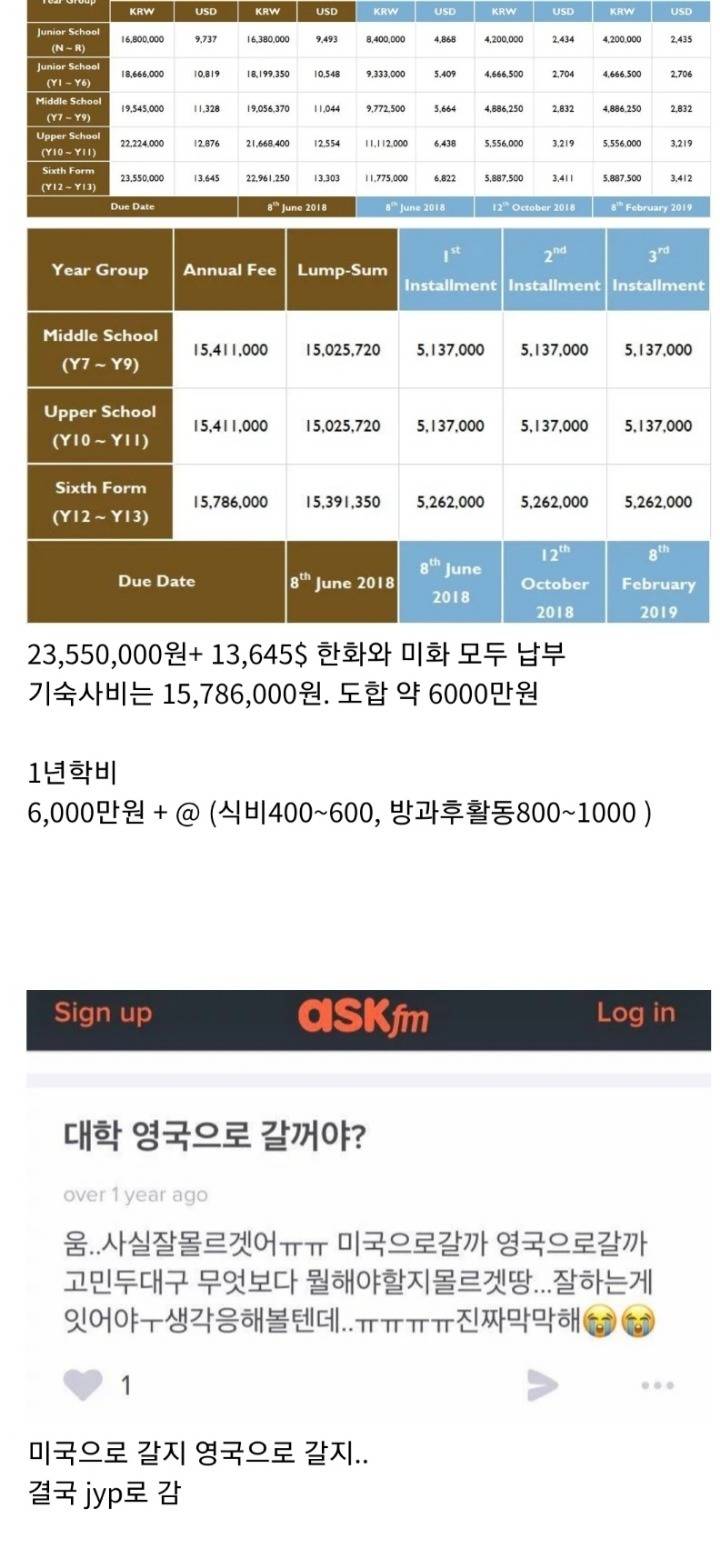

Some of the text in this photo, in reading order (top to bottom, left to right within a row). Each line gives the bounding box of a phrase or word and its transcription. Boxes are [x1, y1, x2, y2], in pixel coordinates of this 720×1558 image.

[129, 7, 155, 16] KRW
[194, 7, 218, 16] USD
[255, 7, 281, 16] KRW
[315, 7, 339, 16] USD
[373, 7, 399, 16] KRW
[434, 7, 456, 16] USD
[491, 7, 517, 16] KRW
[552, 7, 575, 16] USD
[610, 7, 635, 16] KRW
[670, 7, 693, 16] USD
[42, 166, 95, 175] Sixth Form
[120, 173, 165, 183] 23,550,000
[194, 173, 220, 183] 13,645
[246, 173, 290, 183] 22,961,250
[314, 173, 341, 183] 13,303
[364, 173, 409, 183] 11,775,000
[433, 173, 457, 183] 6,822
[484, 173, 524, 183] 5,887,500
[552, 173, 575, 183] 3,411
[602, 173, 642, 183] 5,887,500
[670, 173, 693, 183] 3,412
[544, 245, 567, 263] 2nd
[648, 245, 670, 263] 3rd
[51, 263, 149, 280] Year Group
[182, 262, 277, 277] Annual Fee
[297, 263, 388, 280] Lump-Sum
[405, 278, 497, 291] Installment
[509, 278, 601, 291] Installment
[613, 278, 705, 291] Installment
[43, 328, 160, 343] Middle School
[194, 342, 269, 358] 15,411,000
[306, 342, 381, 358] 15,025,720
[416, 342, 485, 358] 5,137,000
[520, 342, 589, 358] 5,137,000
[624, 342, 693, 358] 5,137,000
[61, 357, 91, 375] (Y7
[110, 357, 140, 375] Y9)
[44, 404, 157, 422] Upper School
[194, 419, 269, 435] 15,411,000
[306, 419, 381, 435] 15,025,720
[416, 419, 485, 435] 5,137,000
[520, 419, 589, 435] 5,137,000
[624, 419, 693, 435] 5,137,000
[52, 433, 91, 451] (Y10
[110, 433, 150, 451] Y11)
[55, 481, 147, 495] Sixth Form
[194, 495, 269, 511] 15,786,000
[306, 495, 381, 511] 15,391,350
[416, 495, 485, 511] 5,262,000
[520, 495, 589, 511] 5,262,000
[624, 495, 693, 511] 5,262,000
[52, 509, 91, 527] (Y12
[110, 509, 150, 527] Y13)
[542, 545, 570, 561] 12th
[648, 545, 670, 561] 8th
[420, 558, 482, 578] 8th June
[118, 574, 196, 588] Due Date
[290, 572, 395, 593] 8th June 2018
[521, 577, 590, 590] October
[622, 577, 697, 594] February
[432, 591, 470, 604] 2018
[536, 606, 574, 619] 2018
[640, 606, 678, 619] 2019
[54, 1000, 153, 1028] Sign up
[597, 1001, 676, 1028] Log in
[64, 1120, 367, 1152] 대학 영국으로 갈꺼야?
[63, 1187, 208, 1206] over 1 year ago
[338, 1230, 489, 1258] 미국으로갈까
[497, 1230, 648, 1258] 영국으로갈까
[64, 1268, 189, 1296] 고민두대구
[198, 1268, 299, 1296] 무엇보다
[121, 1374, 131, 1396] 1
